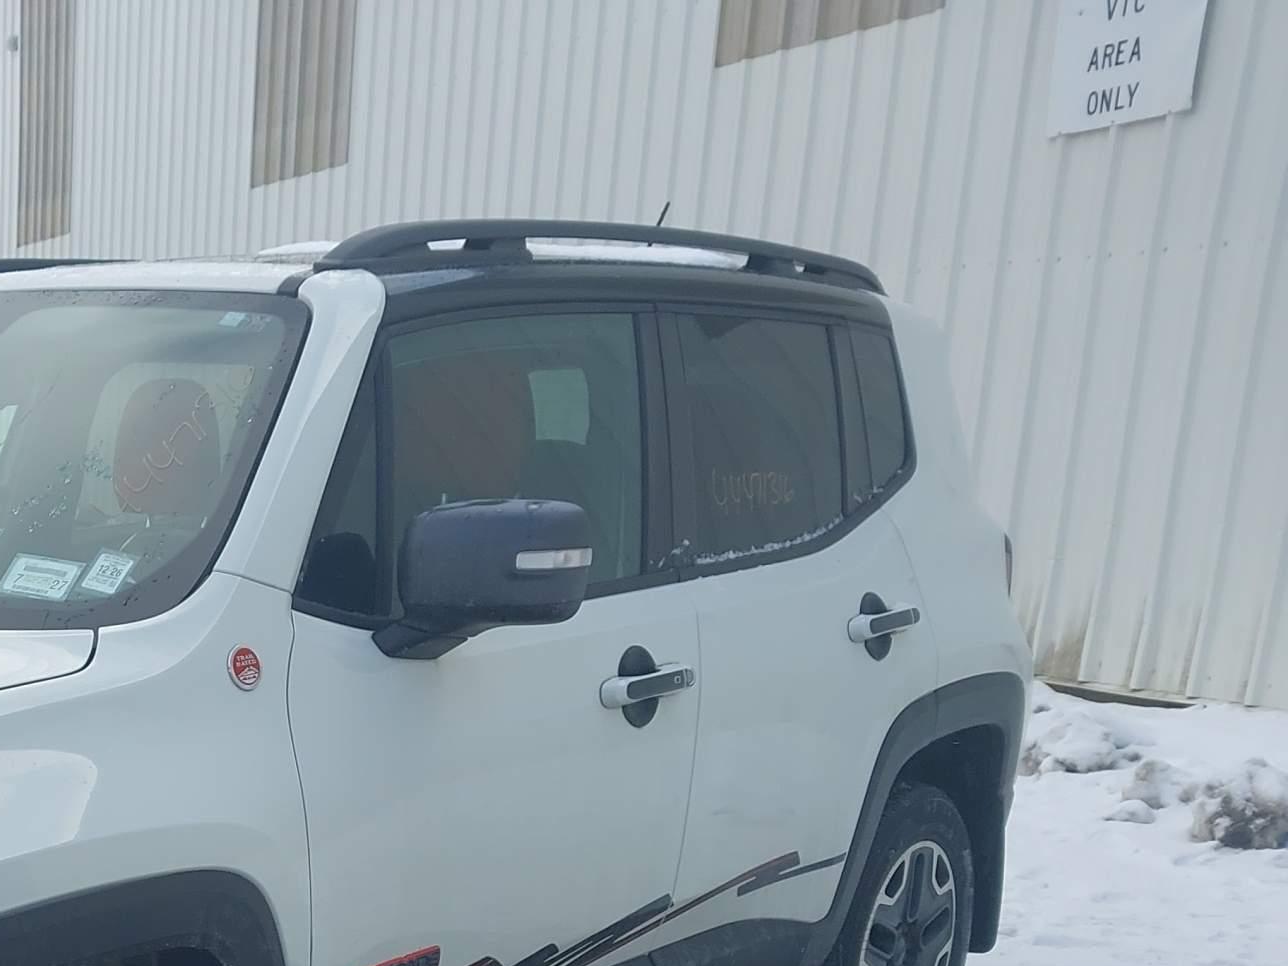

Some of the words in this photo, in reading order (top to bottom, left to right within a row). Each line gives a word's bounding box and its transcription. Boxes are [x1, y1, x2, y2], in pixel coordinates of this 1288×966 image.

[1086, 36, 1141, 73] AREA
[1086, 81, 1140, 115] ONLY
[13, 573, 25, 584] 7
[48, 580, 69, 591] 27
[98, 564, 110, 575] 12
[110, 567, 124, 577] 26
